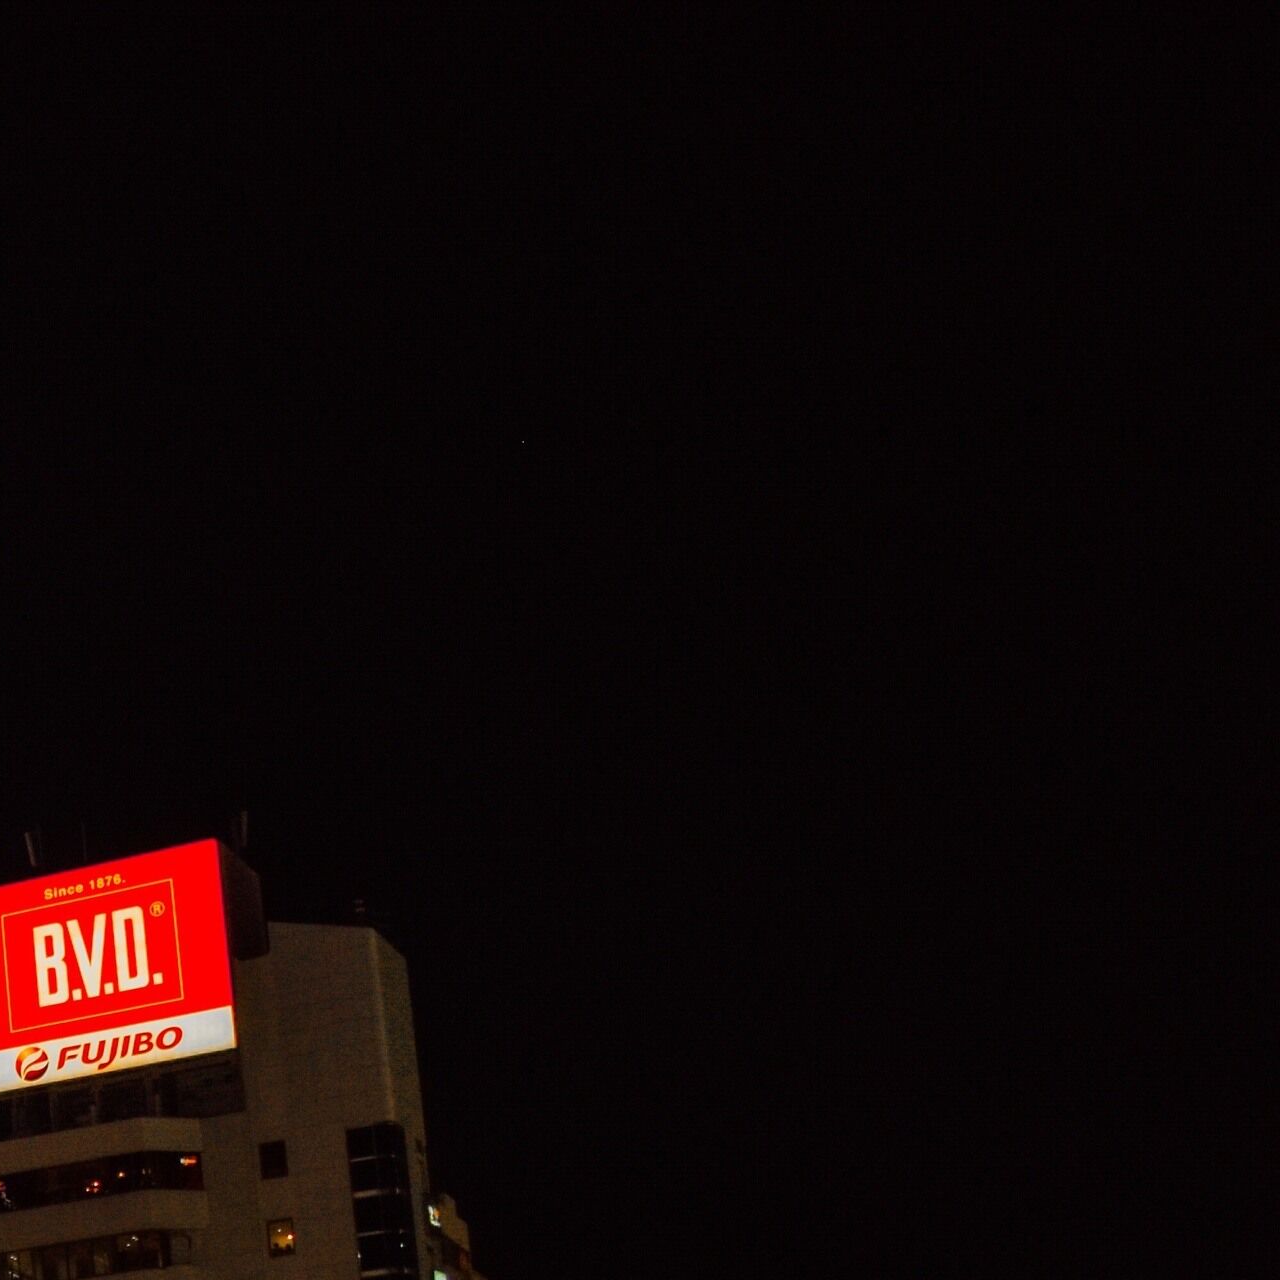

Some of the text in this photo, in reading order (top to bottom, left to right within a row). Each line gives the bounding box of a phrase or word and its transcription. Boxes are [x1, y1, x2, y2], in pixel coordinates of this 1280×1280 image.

[44, 873, 126, 900] Since 1876.
[32, 905, 164, 1008] B.V.D.
[56, 1025, 184, 1071] FUJIBO
